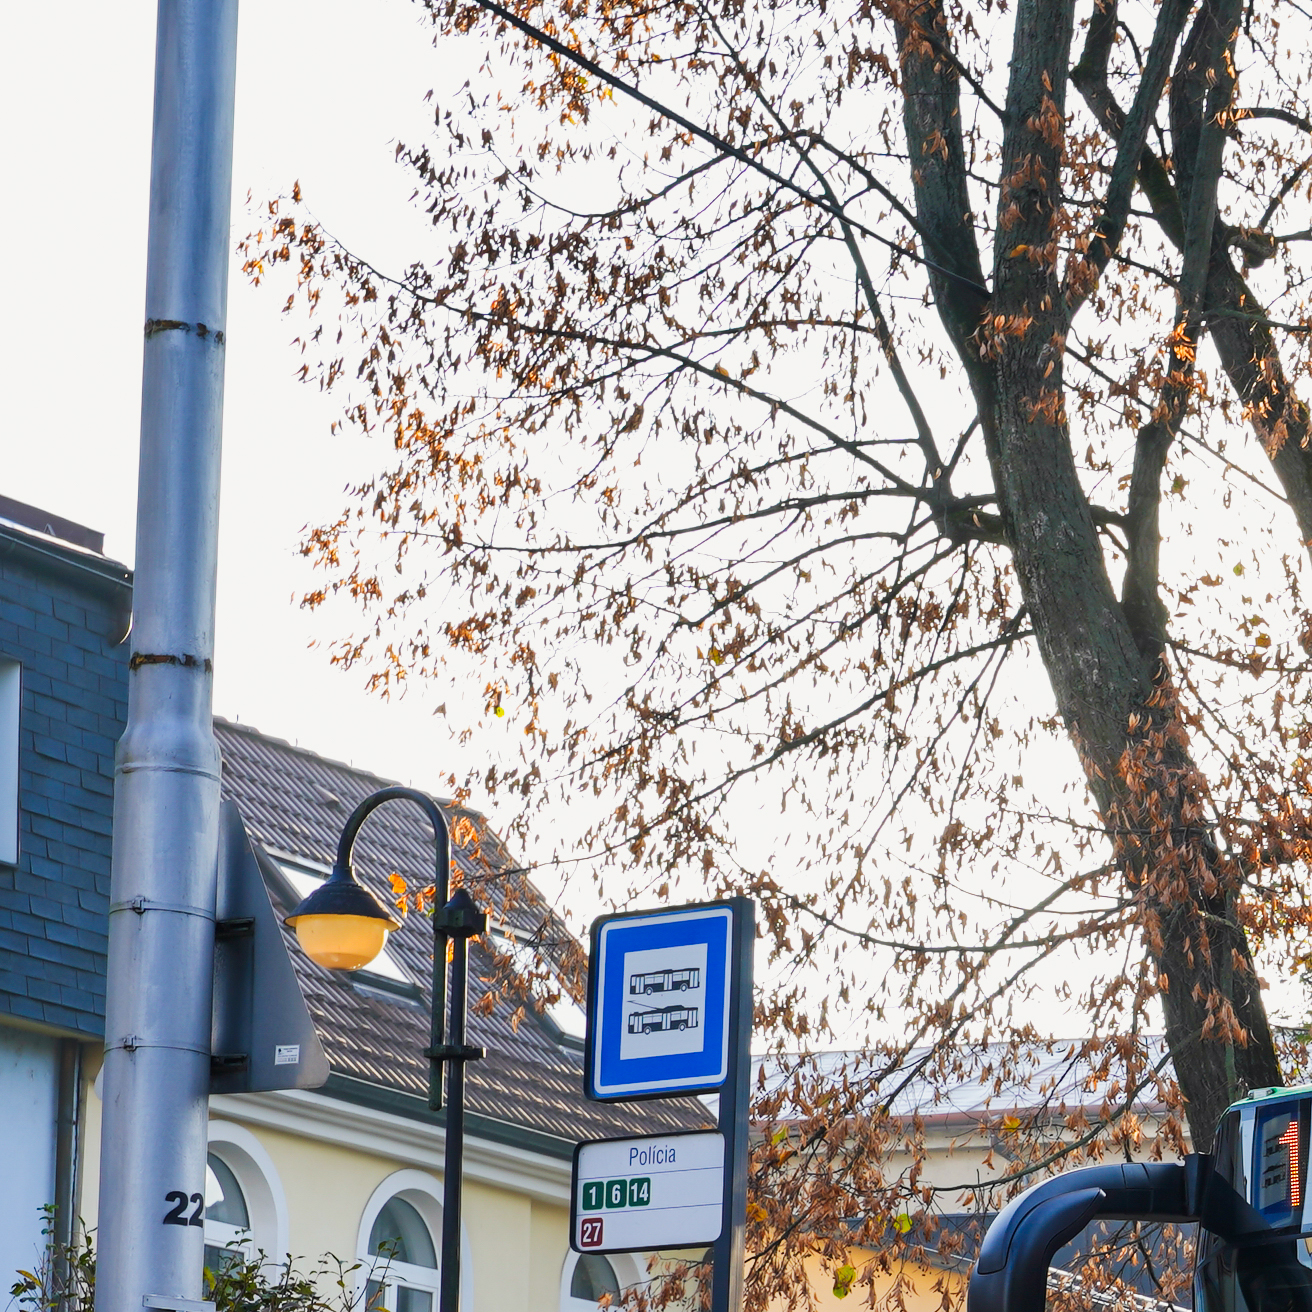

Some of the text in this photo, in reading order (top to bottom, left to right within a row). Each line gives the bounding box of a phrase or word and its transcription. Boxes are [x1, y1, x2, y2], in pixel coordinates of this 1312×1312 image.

[629, 1145, 676, 1166] Polícia
[1278, 1120, 1300, 1207] 1
[589, 1182, 649, 1206] 1 6 14
[582, 1222, 602, 1242] 27
